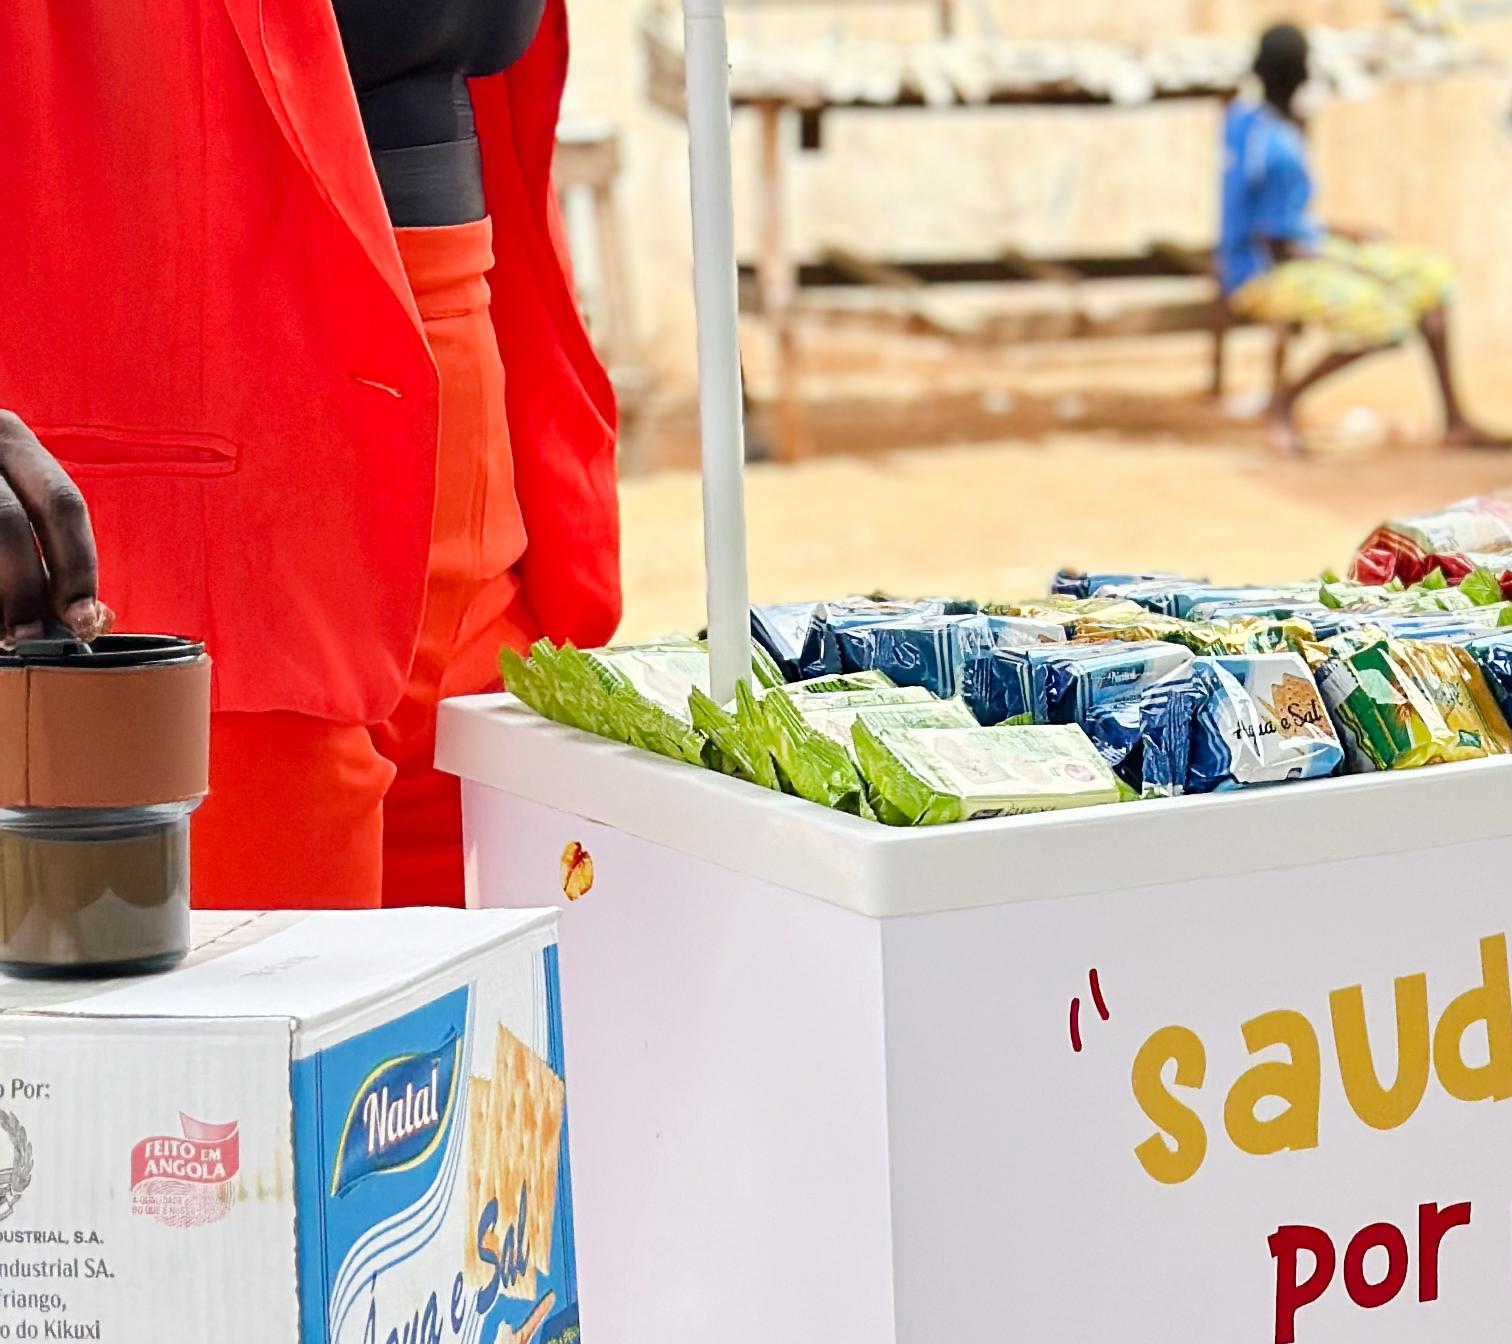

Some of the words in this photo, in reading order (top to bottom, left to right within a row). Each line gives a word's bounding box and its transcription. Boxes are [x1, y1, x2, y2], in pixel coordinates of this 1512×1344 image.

[1281, 717, 1290, 730] e
[1288, 698, 1322, 727] Sal
[363, 1066, 441, 1155] Natal
[144, 1140, 196, 1158] FEITO
[201, 1148, 221, 1161] EM
[144, 1158, 226, 1179] ANGOLA
[450, 1271, 467, 1336] e
[477, 1179, 531, 1316] Sal
[84, 1258, 115, 1279] SA.
[16, 1320, 38, 1340] do
[44, 1319, 102, 1340] Kikuxi
